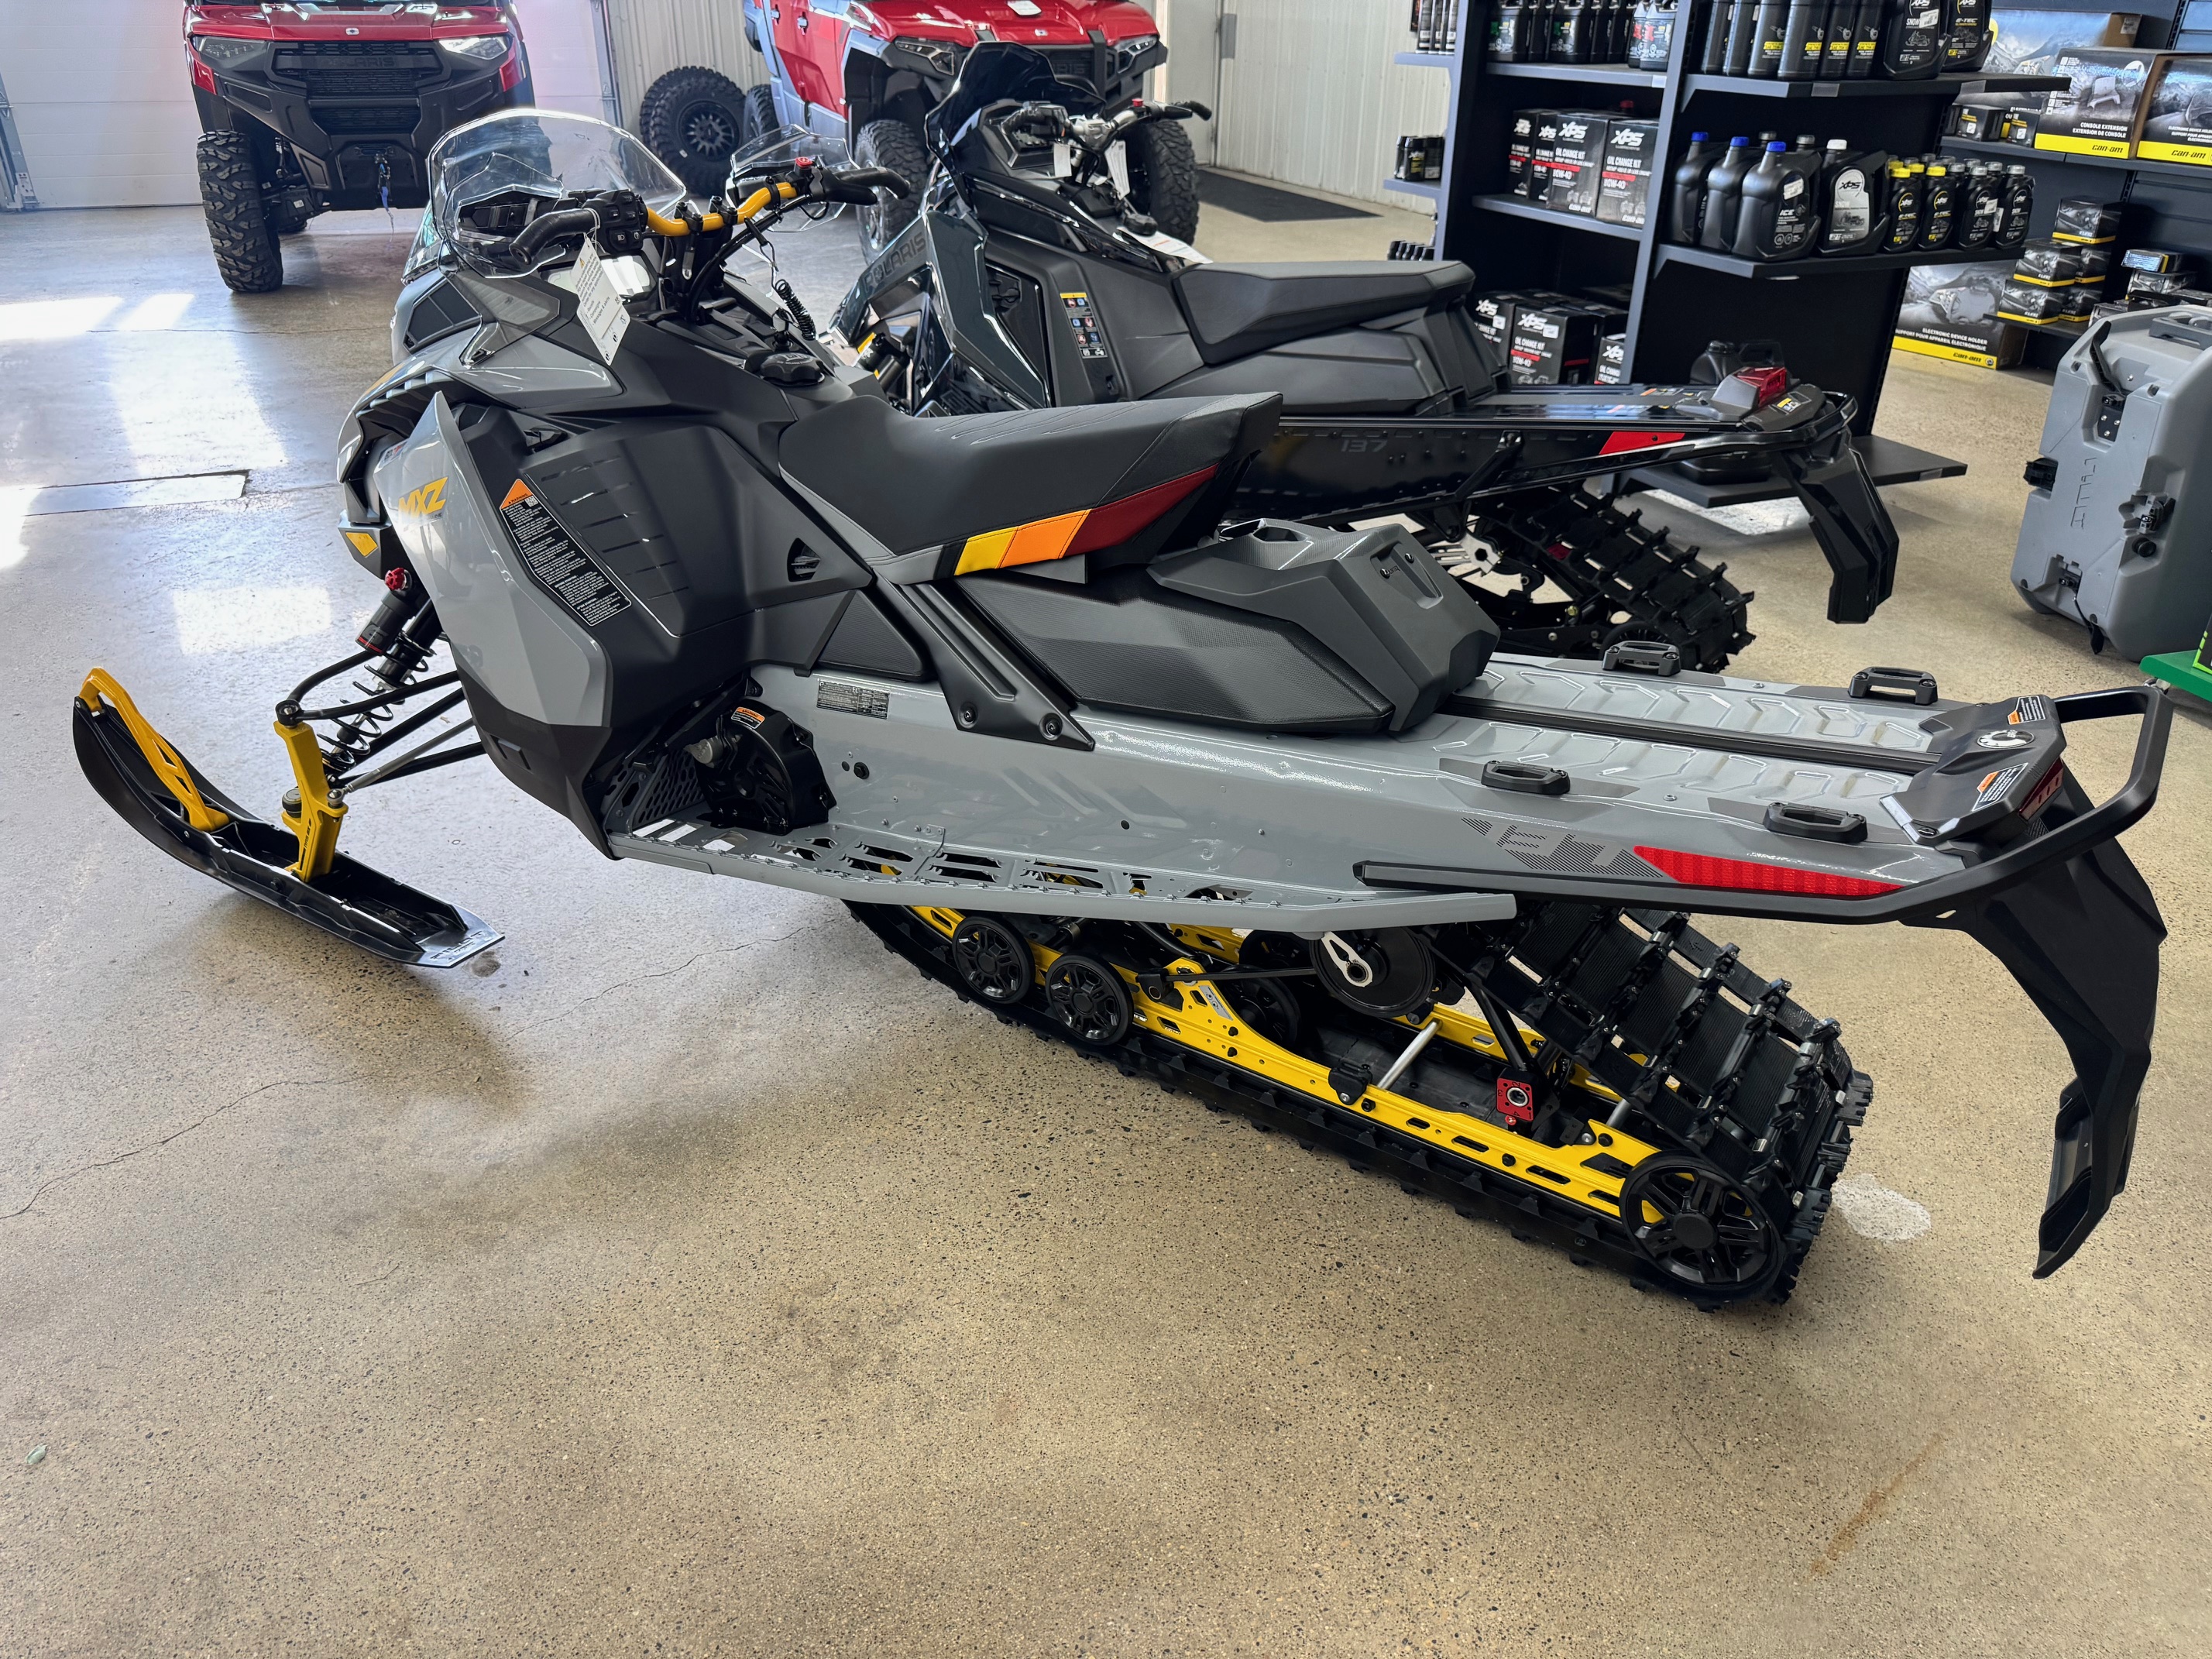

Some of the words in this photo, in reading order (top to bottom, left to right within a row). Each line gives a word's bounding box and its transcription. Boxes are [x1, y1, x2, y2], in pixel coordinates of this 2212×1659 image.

[1558, 122, 1588, 139] XPS
[2101, 123, 2128, 132] EXTENSION
[1611, 129, 1644, 146] XPS
[1562, 148, 1578, 159] CHANGE
[2092, 145, 2123, 153] can-am
[2171, 149, 2207, 159] can-am
[1615, 156, 1633, 167] CHANGE
[1633, 159, 1642, 168] KIT
[1839, 180, 1861, 189] XPS
[864, 232, 926, 293] POLARIS
[1475, 299, 1499, 316] XPS
[1517, 313, 1547, 330] XPS
[1922, 328, 1950, 338] ELECTRONIC
[1968, 336, 1988, 345] HOLDER
[1929, 335, 1951, 345] APPAREIL
[1521, 338, 1537, 349] CHANGE
[1537, 341, 1546, 350] KIT
[1953, 352, 1981, 362] can-am
[1341, 440, 1388, 452] 137
[398, 476, 448, 518] MXZ
[511, 493, 528, 503] WARNING
